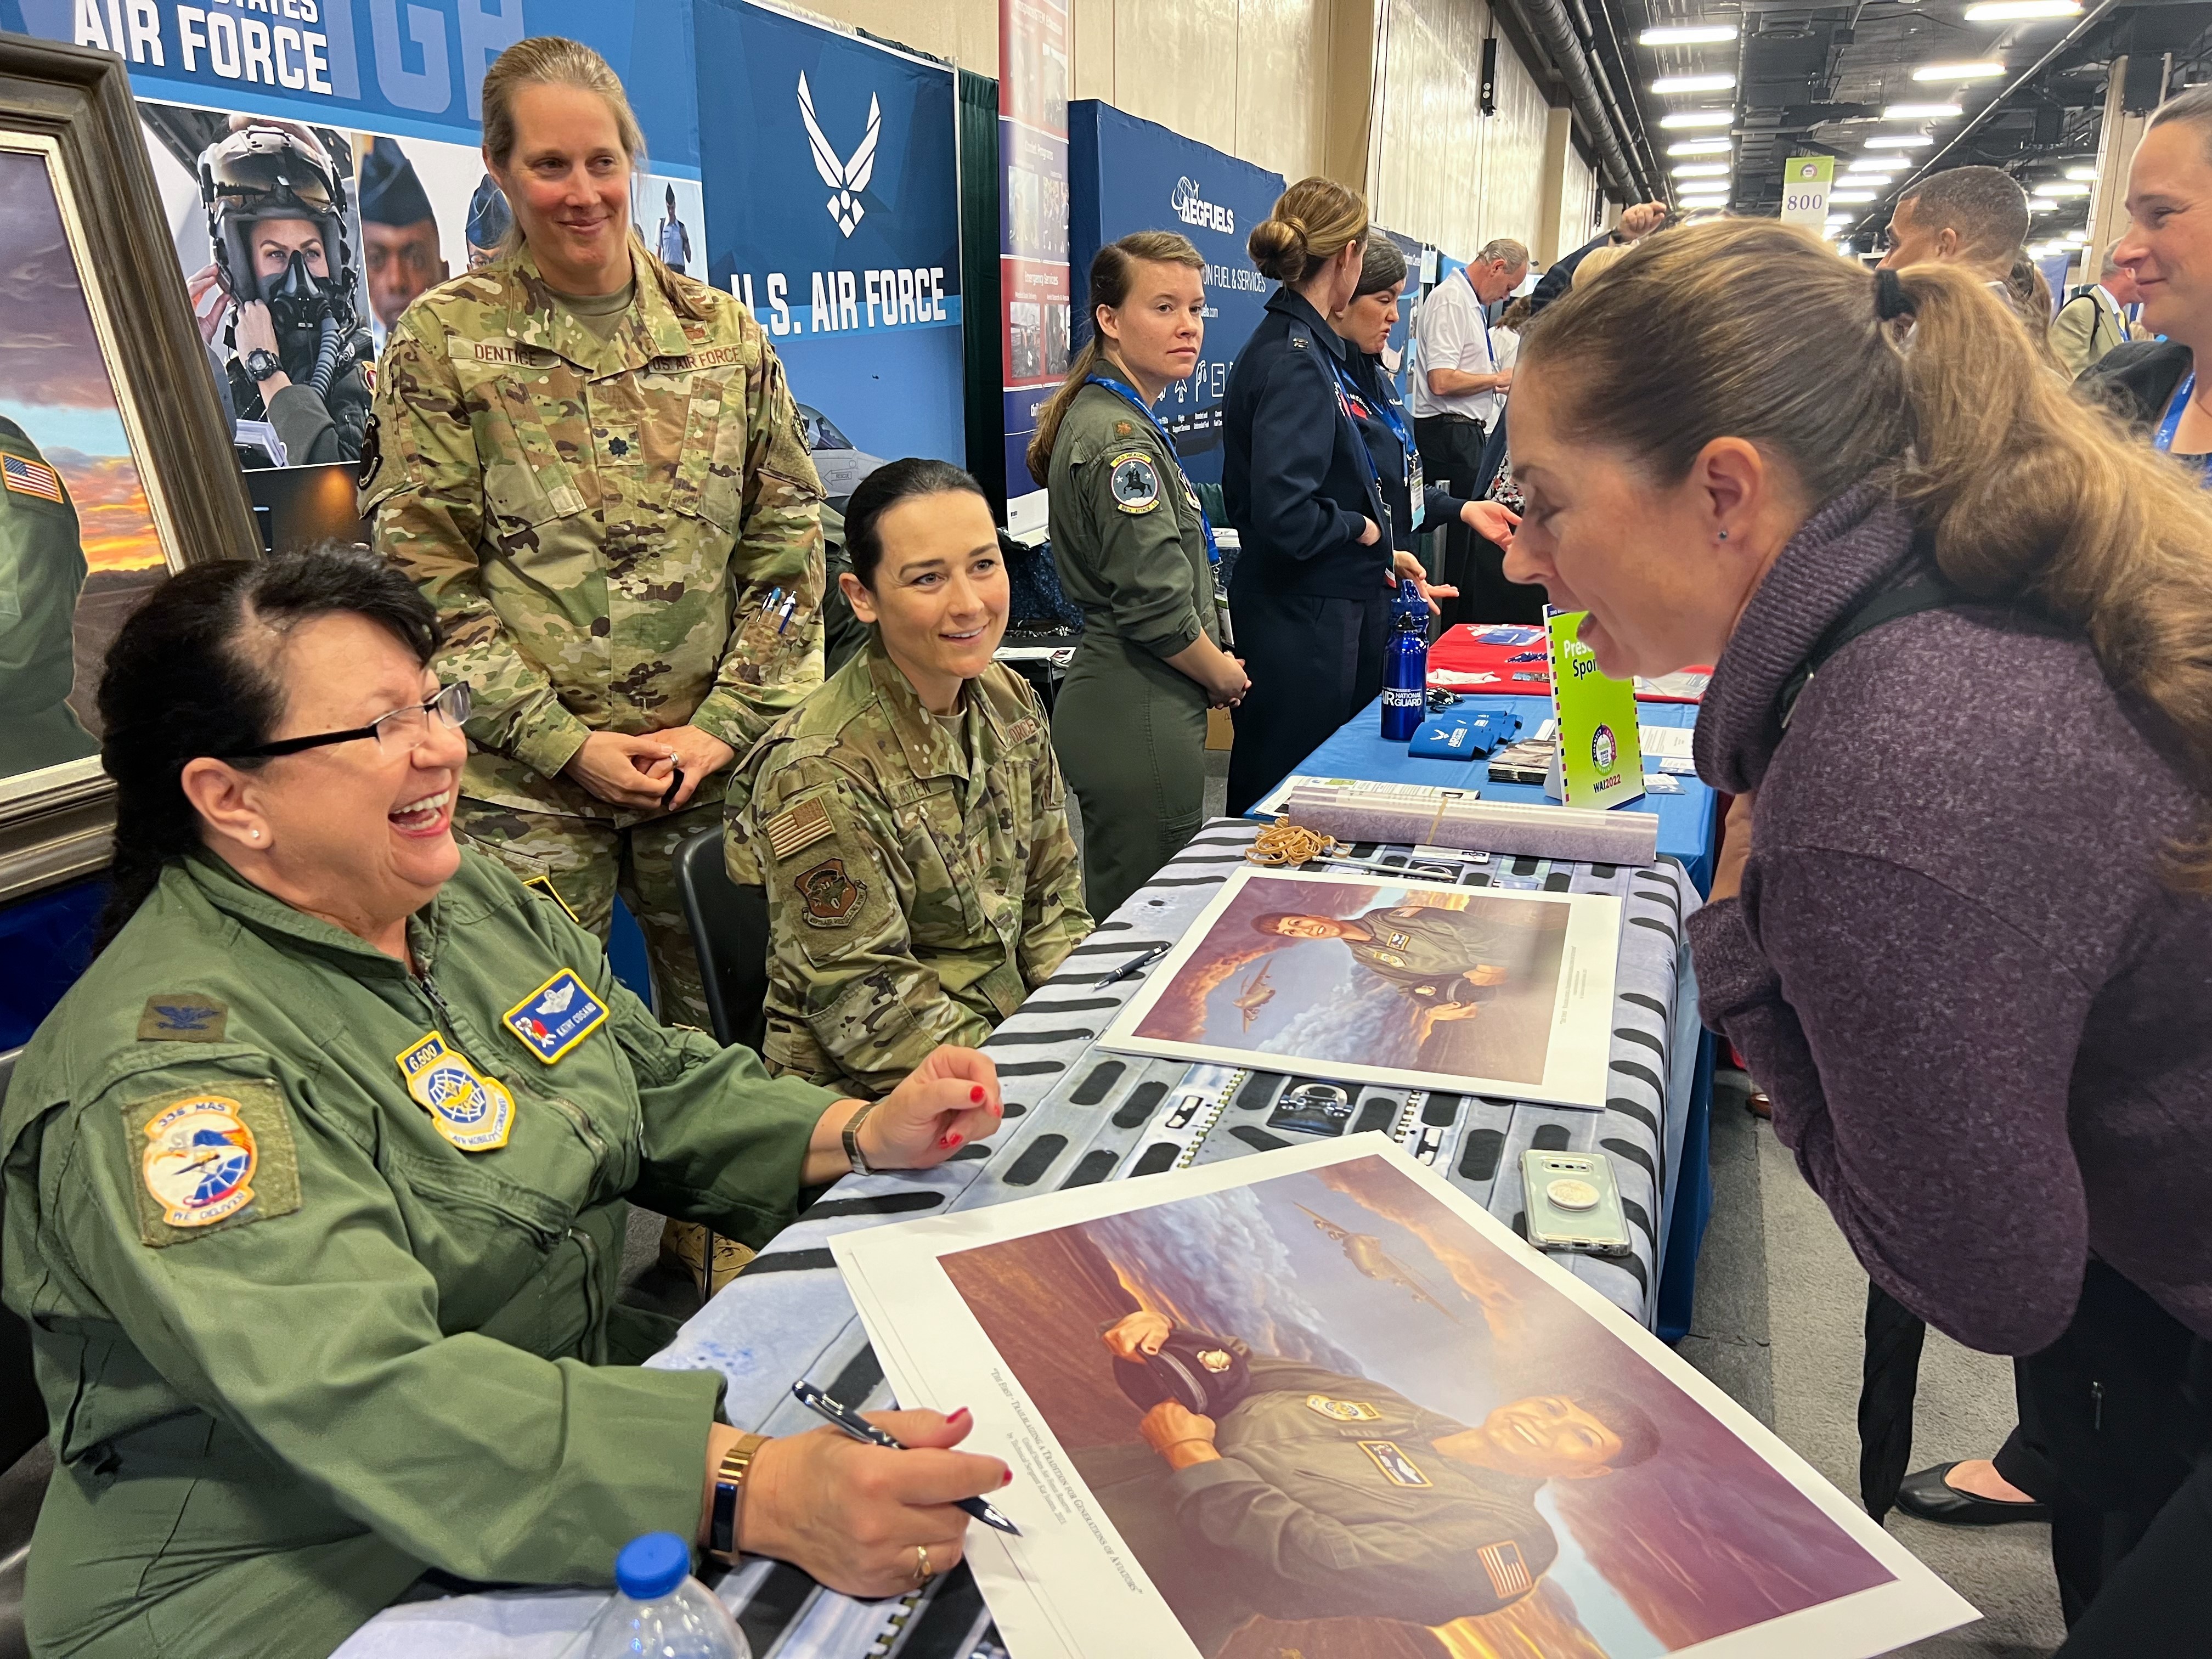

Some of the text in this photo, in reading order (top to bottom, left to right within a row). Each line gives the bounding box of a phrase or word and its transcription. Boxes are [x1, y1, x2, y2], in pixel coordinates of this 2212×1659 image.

[75, 0, 332, 95] AIR FORCE
[1787, 194, 1822, 210] 800
[1181, 196, 1234, 235] AEGFUELS
[1214, 265, 1231, 288] FUEL
[1232, 268, 1236, 289] &
[1237, 269, 1266, 292] SERVICES
[812, 270, 859, 333] AIR
[864, 267, 946, 328] FORCE
[475, 344, 537, 366] DENTICE
[676, 353, 698, 370] AIR
[699, 347, 741, 367] FORCE
[1394, 698, 1422, 707] GUARD
[1009, 718, 1036, 743] ORCE
[898, 780, 932, 803] USTEN
[1593, 774, 1621, 793] WAI2022
[195, 1102, 225, 1113] MAS
[1043, 1449, 1069, 1486] TRADITION
[1065, 1486, 1077, 1499] FOR
[1074, 1499, 1107, 1546] GENERATIONS
[1103, 1545, 1115, 1555] OF
